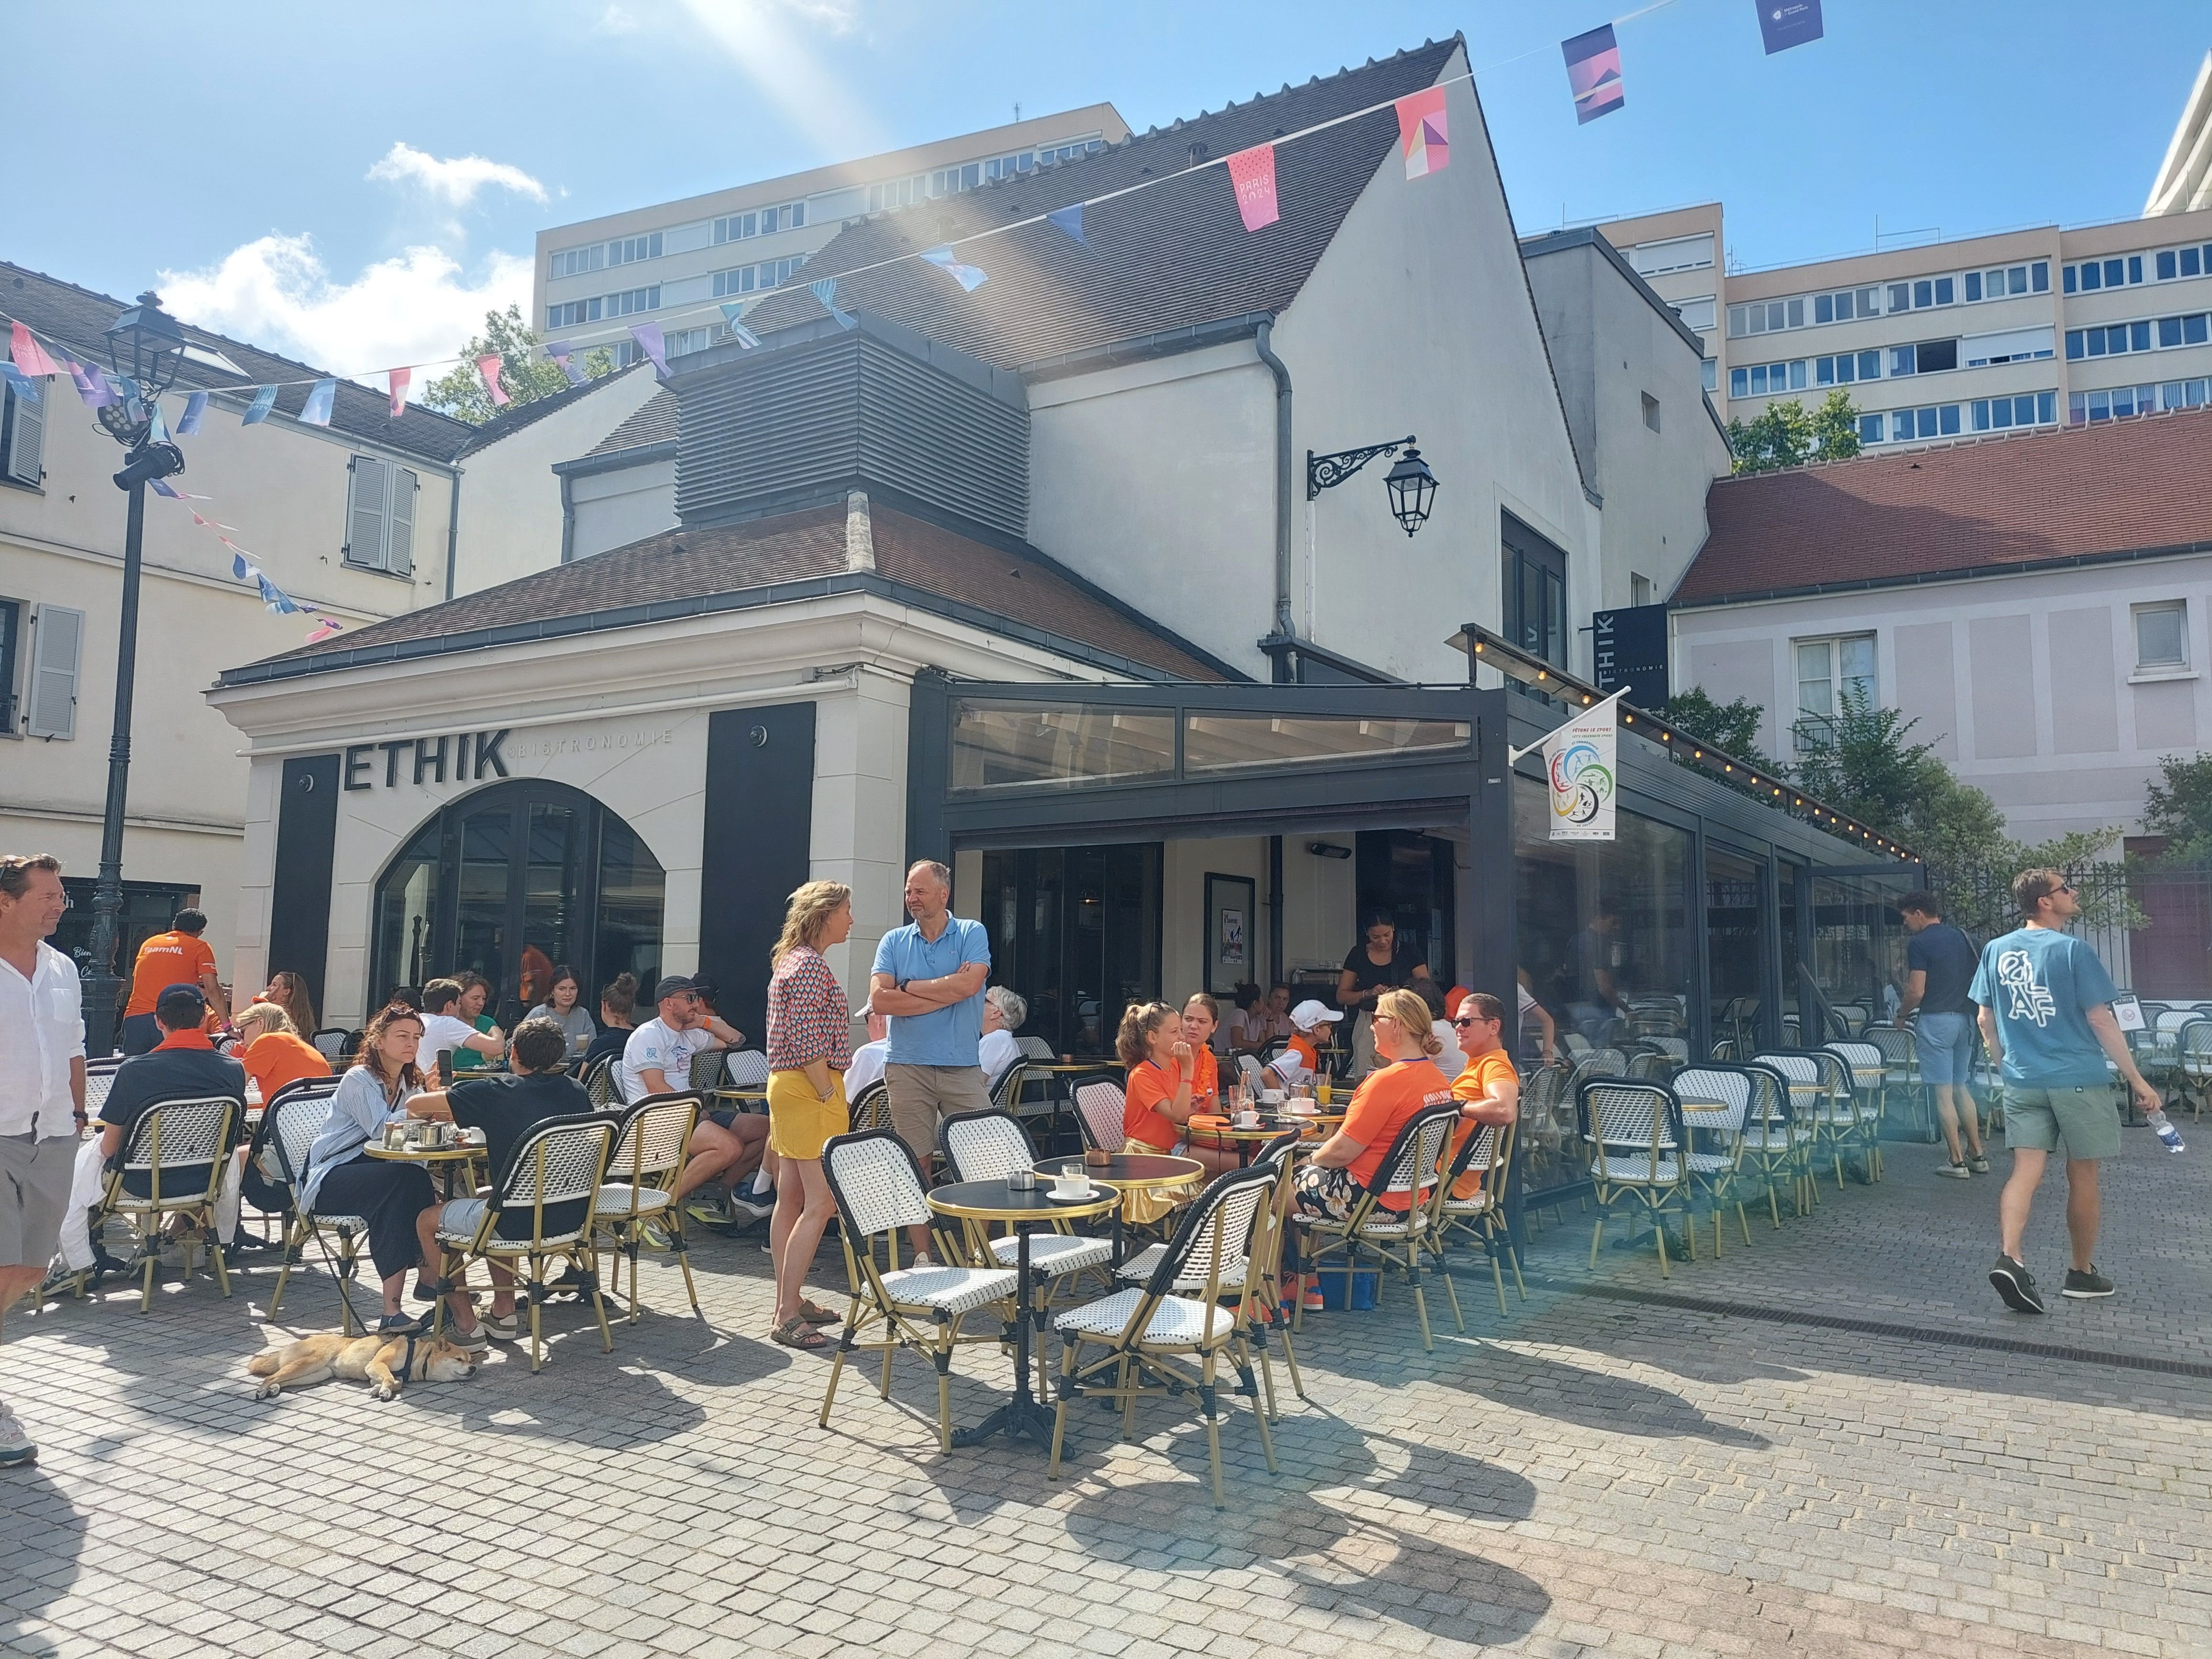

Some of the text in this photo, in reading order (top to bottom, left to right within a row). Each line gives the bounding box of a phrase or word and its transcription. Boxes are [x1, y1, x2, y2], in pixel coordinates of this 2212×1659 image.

[1239, 175, 1269, 194] PARIS
[1242, 187, 1270, 205] 2024
[13, 341, 36, 352] PARIS
[1597, 615, 1615, 689] THIK
[1603, 664, 1663, 675] BISTRONOMIE
[343, 728, 672, 791] ETHIK BISTRONOMIE
[144, 946, 183, 955] TeamNL
